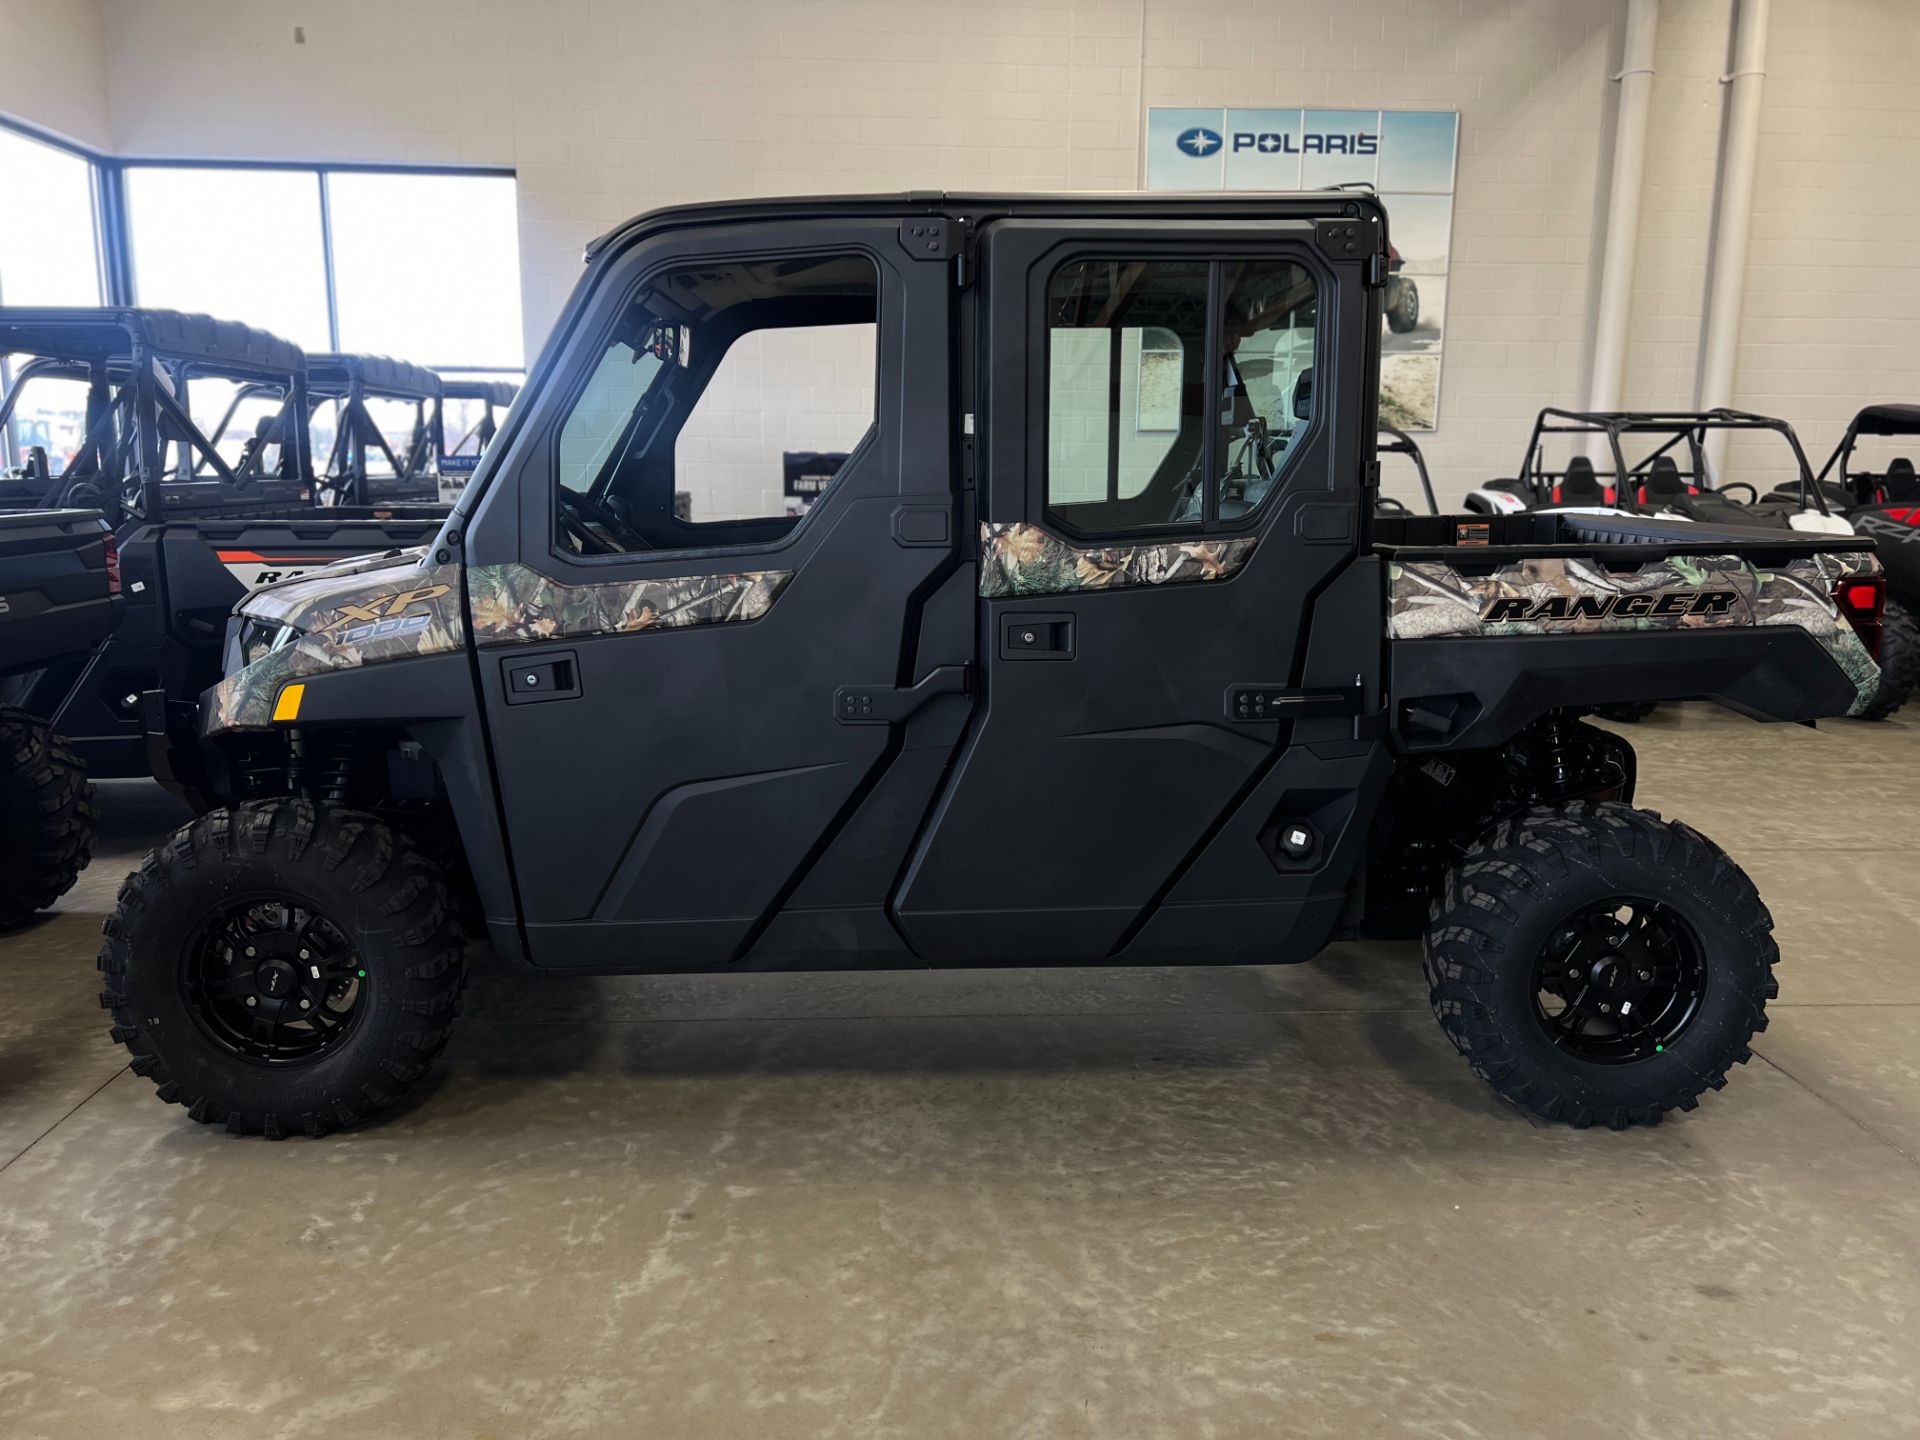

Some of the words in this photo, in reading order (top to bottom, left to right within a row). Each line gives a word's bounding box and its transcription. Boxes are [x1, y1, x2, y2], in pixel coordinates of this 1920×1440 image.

[1233, 133, 1378, 155] POLARIS
[313, 583, 452, 636] XP
[1481, 591, 1739, 622] RANGER
[336, 612, 432, 645] 1000
